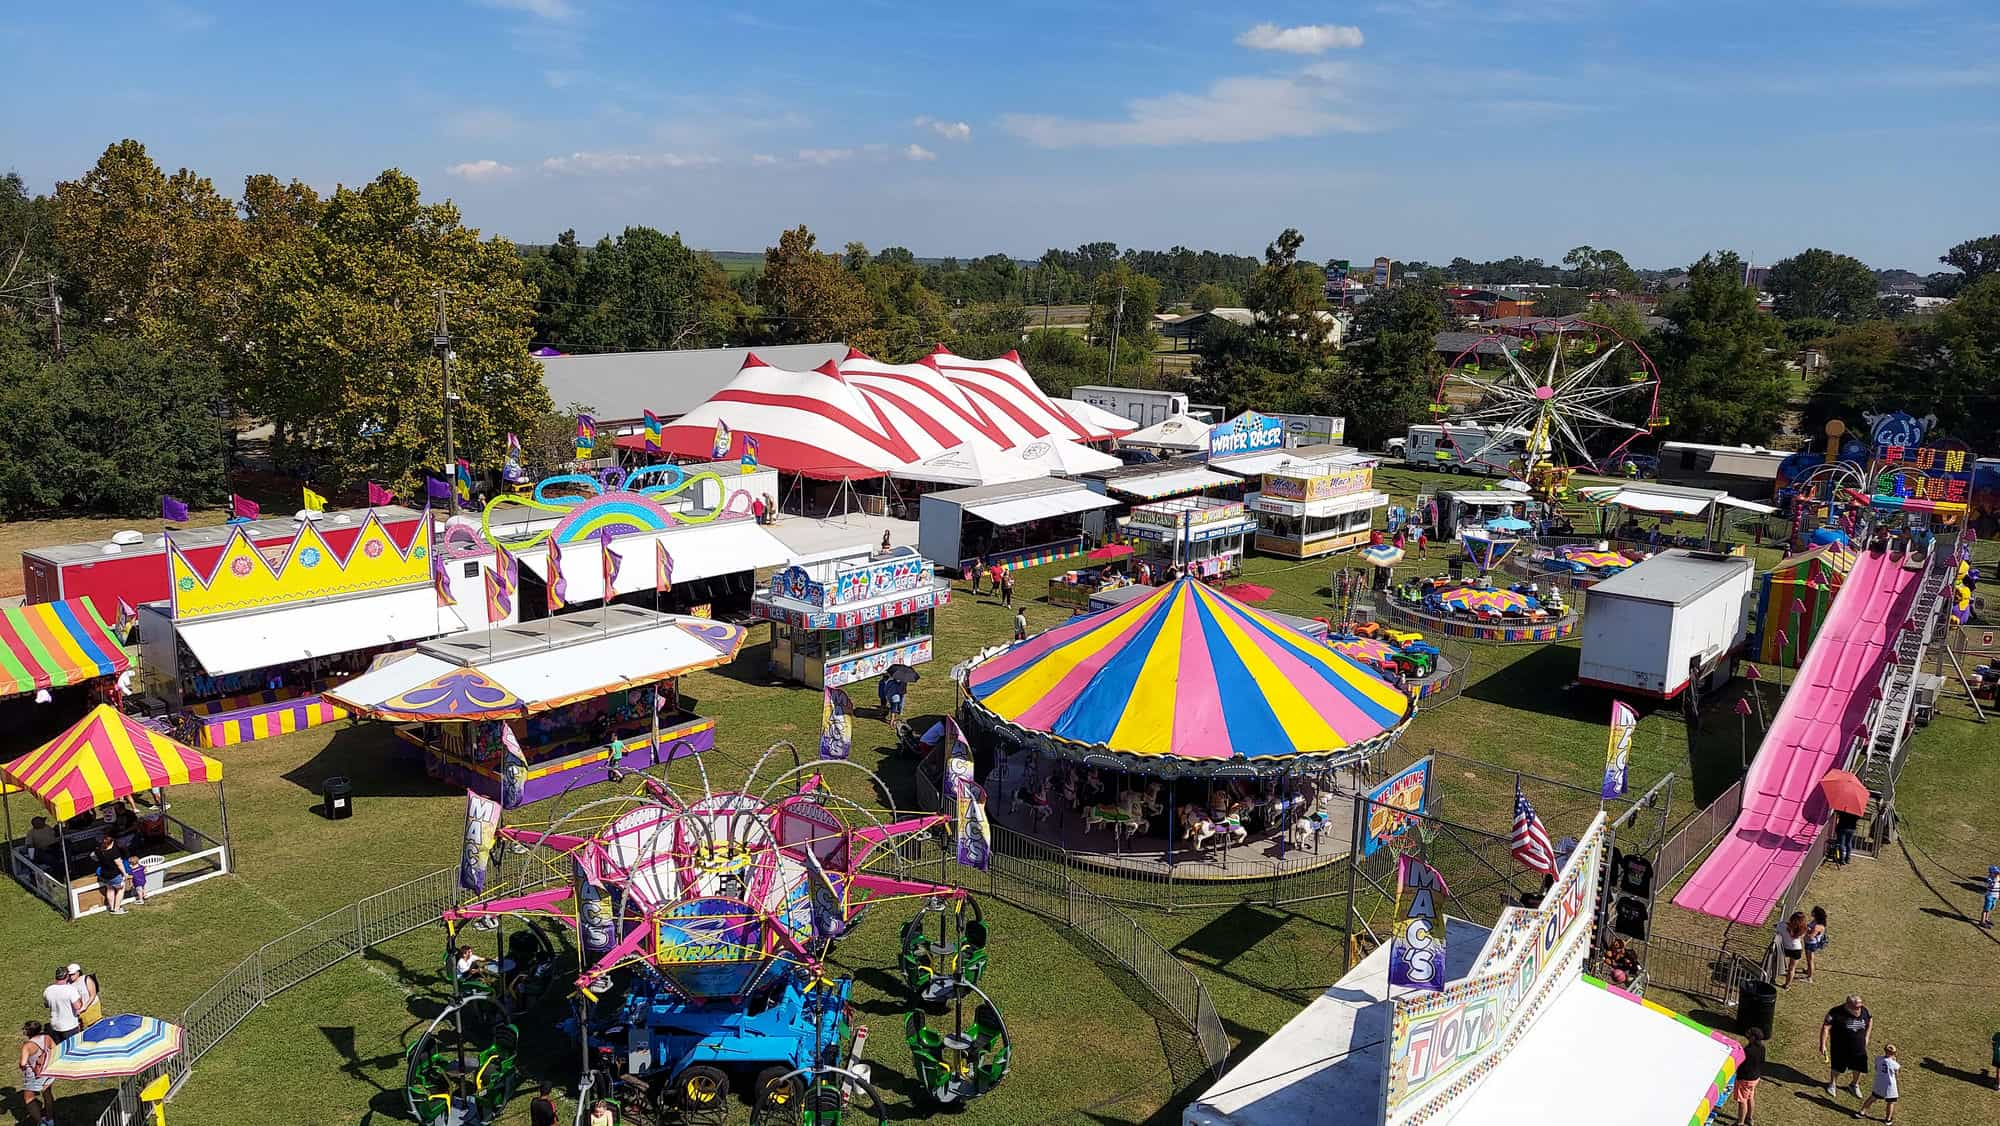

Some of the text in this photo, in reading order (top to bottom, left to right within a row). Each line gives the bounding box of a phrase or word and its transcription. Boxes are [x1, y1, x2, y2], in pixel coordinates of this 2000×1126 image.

[1211, 428, 1282, 453] WATER RACER
[1885, 445, 1966, 472] FUN
[1876, 472, 1966, 502] SLIDE
[861, 604, 880, 621] ICEE
[916, 592, 932, 608] ICEE
[1401, 770, 1425, 789] WINS
[1405, 860, 1442, 982] MAC'S
[1410, 1013, 1481, 1077] TOY
